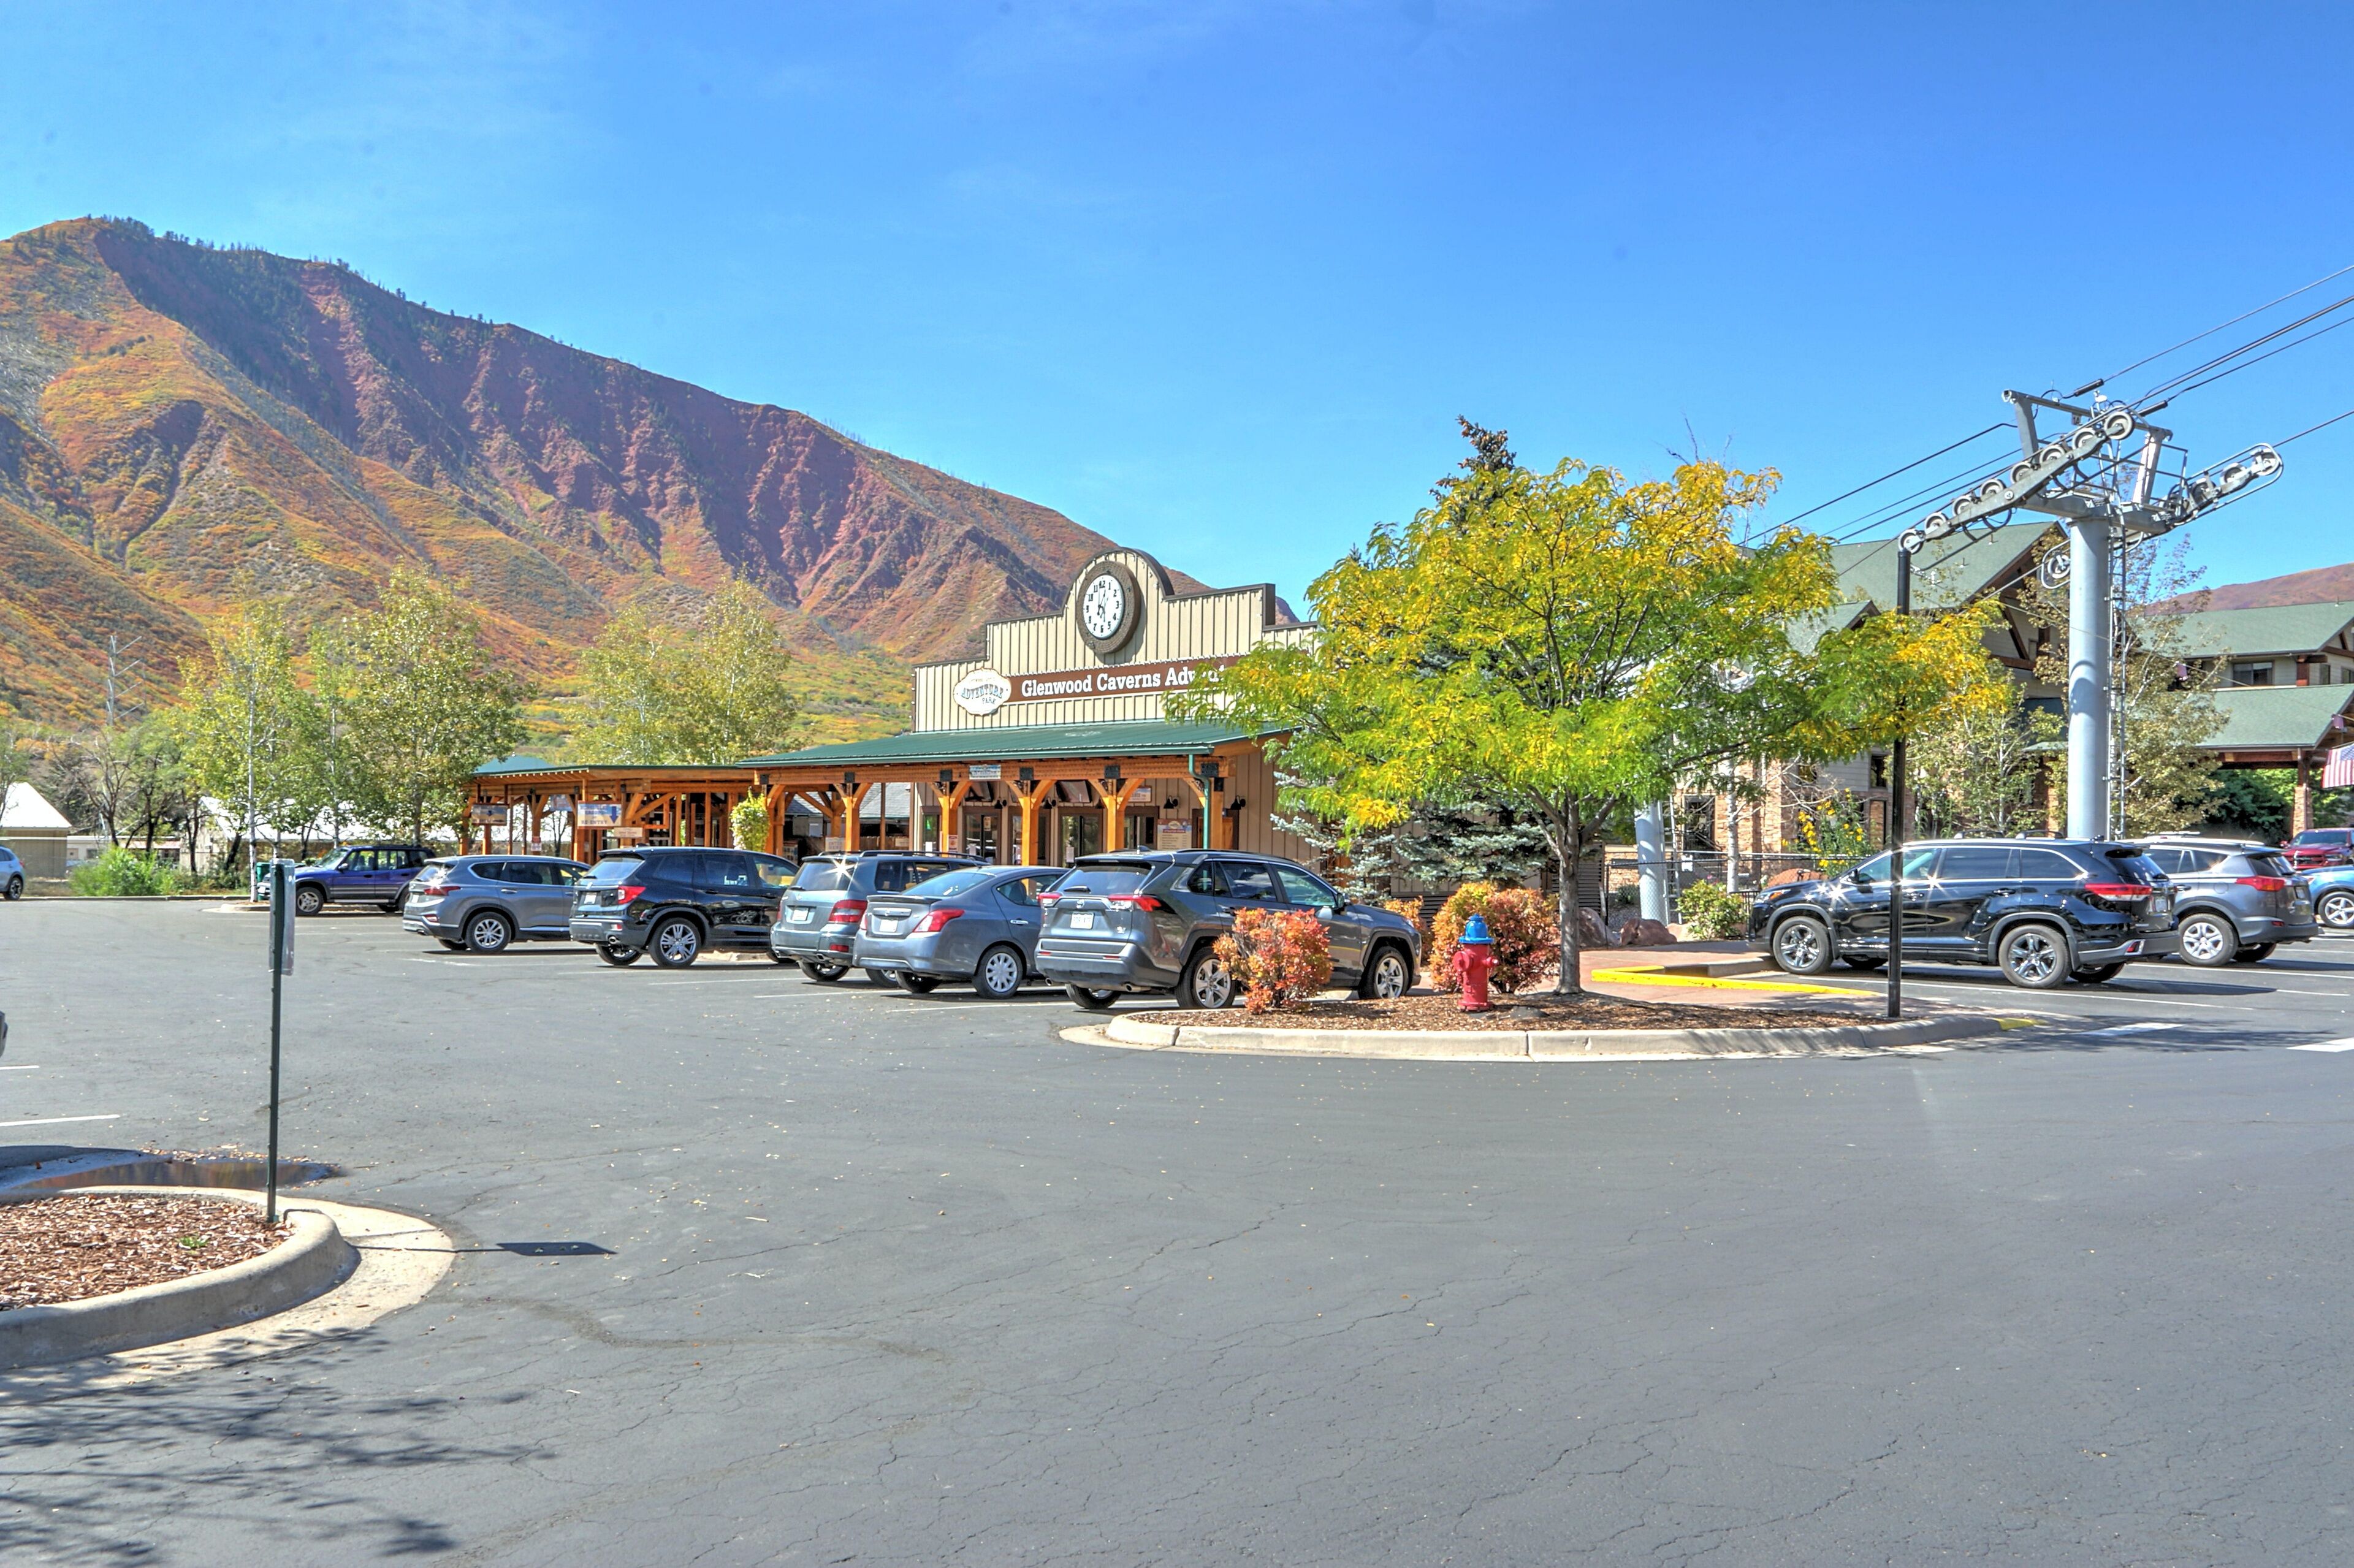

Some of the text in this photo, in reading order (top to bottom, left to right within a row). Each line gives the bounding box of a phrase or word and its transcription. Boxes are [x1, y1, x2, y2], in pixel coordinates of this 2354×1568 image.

[961, 683, 1004, 699] ADVENTURE
[1021, 674, 1092, 698] Glenwood
[1097, 672, 1161, 691] Caverns
